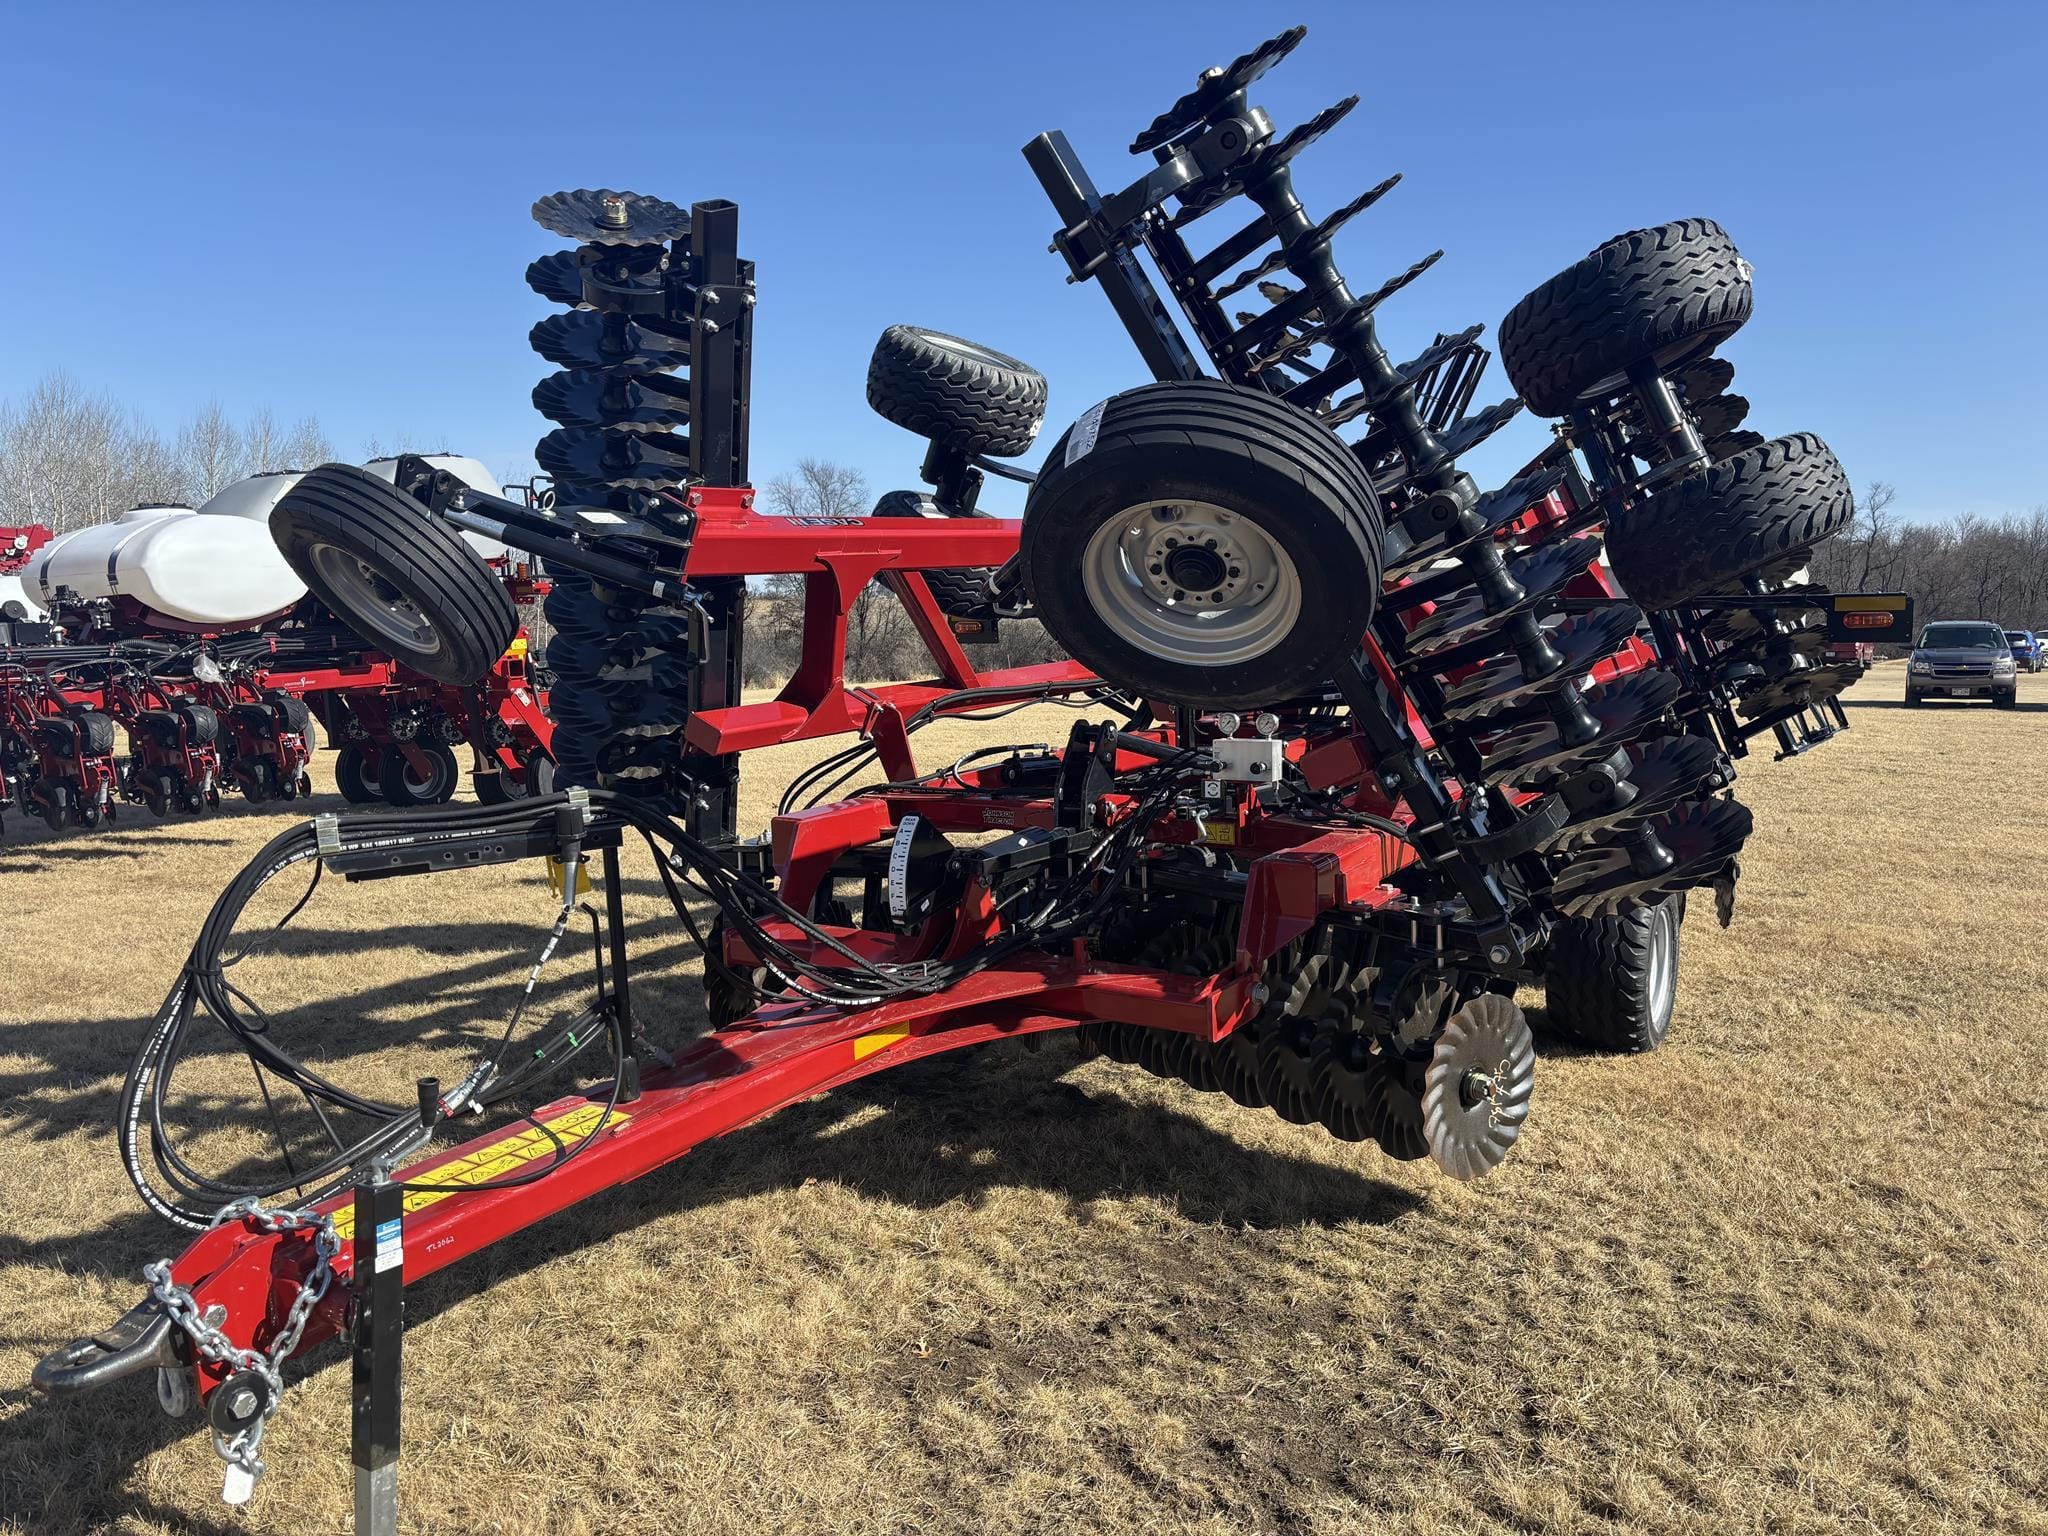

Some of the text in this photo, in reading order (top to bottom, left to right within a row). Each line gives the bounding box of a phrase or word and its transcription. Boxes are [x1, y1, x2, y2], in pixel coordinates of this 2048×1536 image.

[807, 517, 865, 527] CASE
[982, 807, 1015, 817] JOHNSON
[983, 816, 1015, 825] TRACTOR
